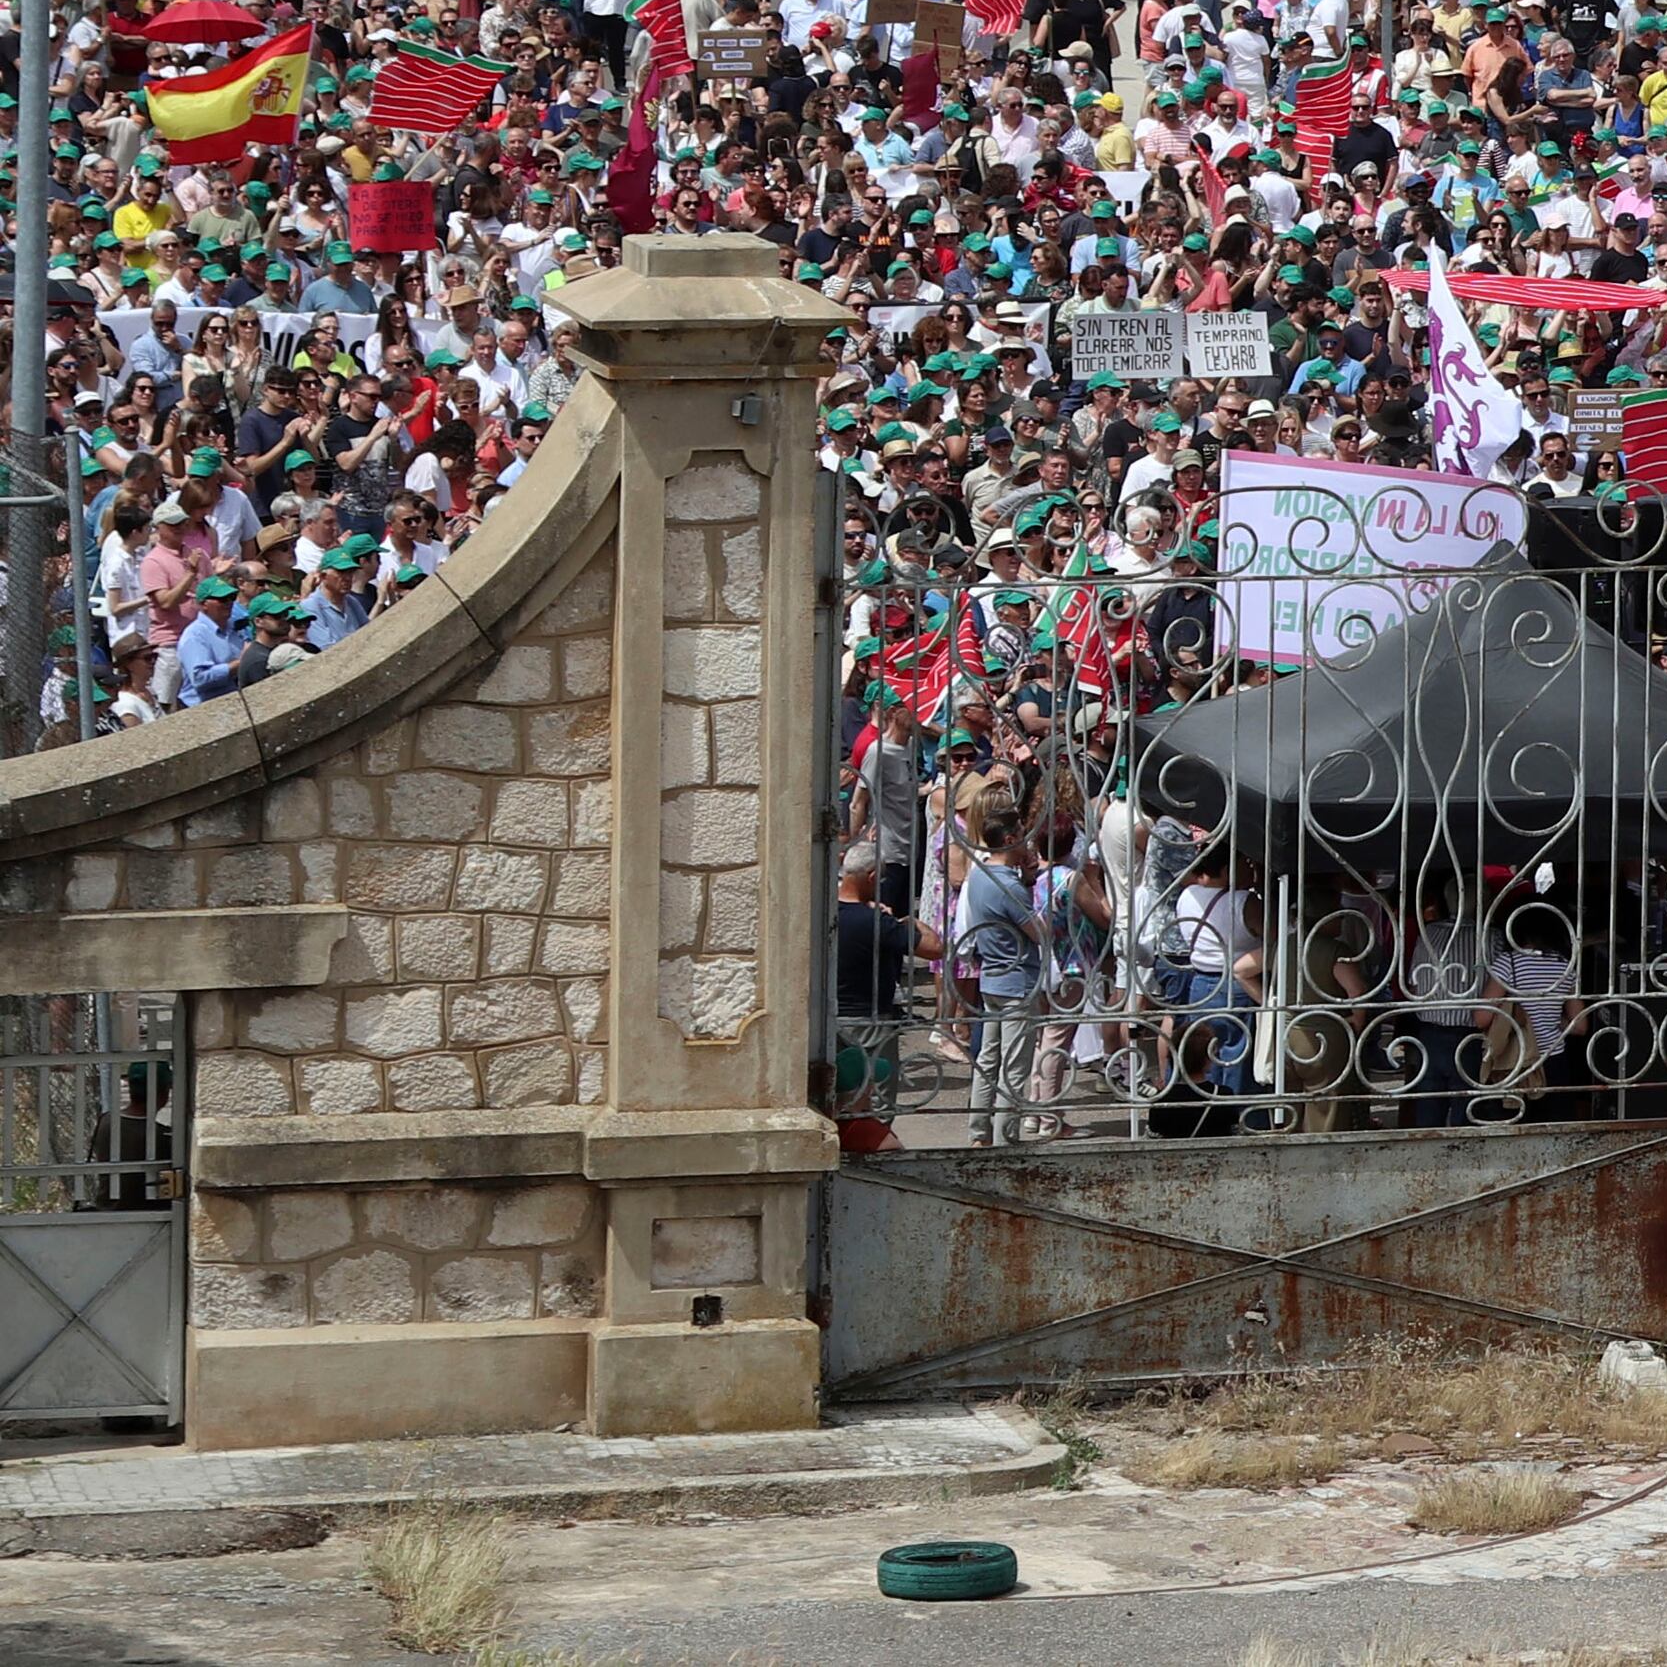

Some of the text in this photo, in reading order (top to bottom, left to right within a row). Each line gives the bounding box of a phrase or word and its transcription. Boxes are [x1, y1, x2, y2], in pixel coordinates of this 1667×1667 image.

[1202, 312, 1253, 326] SIN AVE
[1077, 318, 1173, 336] SIN TREN AL
[1146, 337, 1172, 352] NOS
[1075, 357, 1106, 372] TOCA
